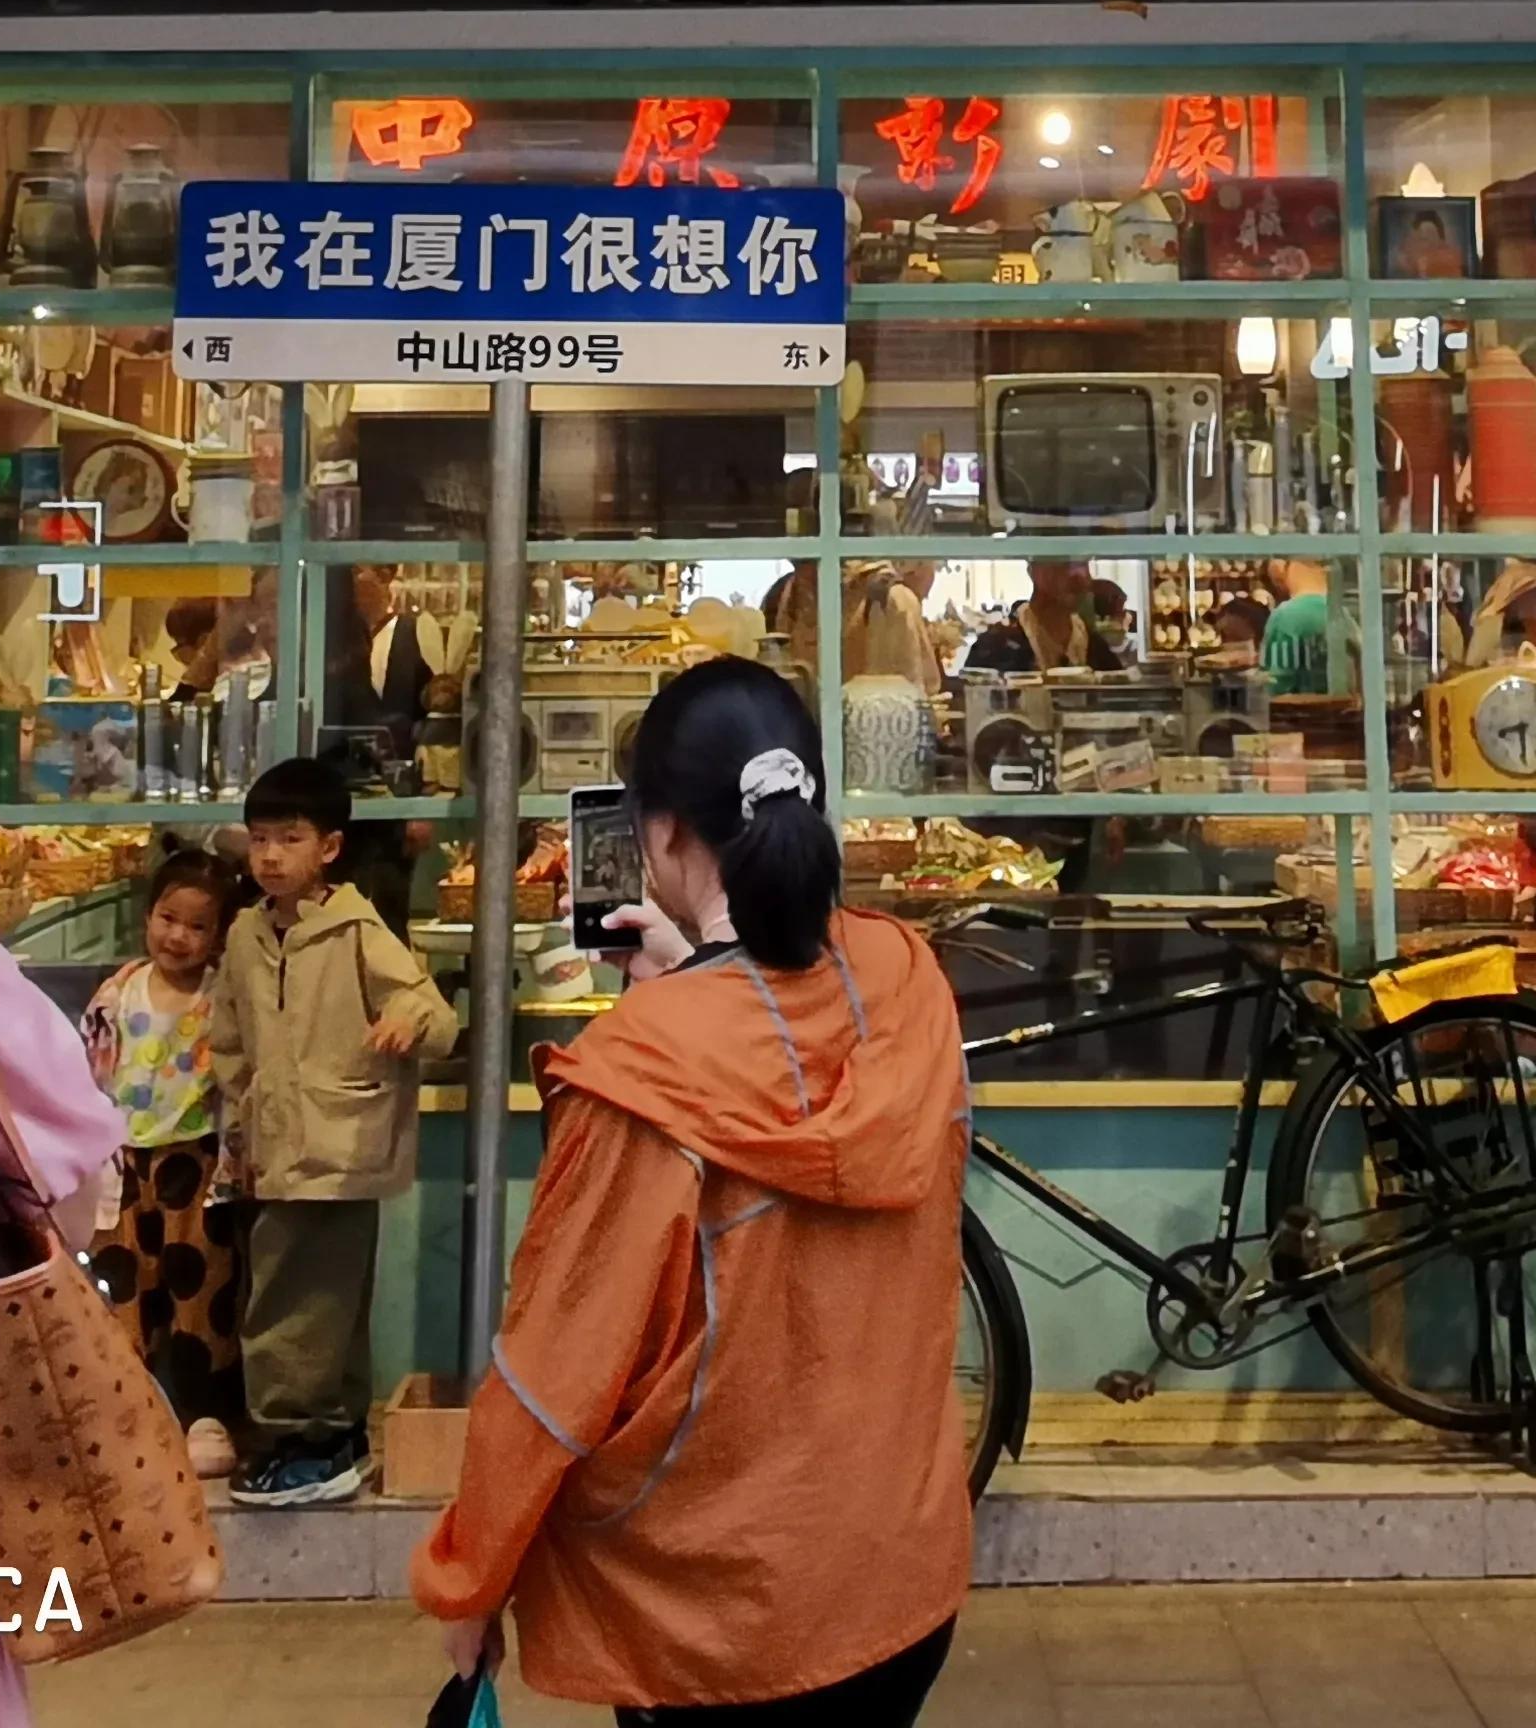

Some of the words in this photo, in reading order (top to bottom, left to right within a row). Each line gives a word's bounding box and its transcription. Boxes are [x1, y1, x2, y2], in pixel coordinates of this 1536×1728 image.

[205, 210, 819, 296] 我在厦门很想你
[204, 336, 233, 364] 西
[397, 330, 624, 374] 中山路99号
[783, 341, 810, 370] 东
